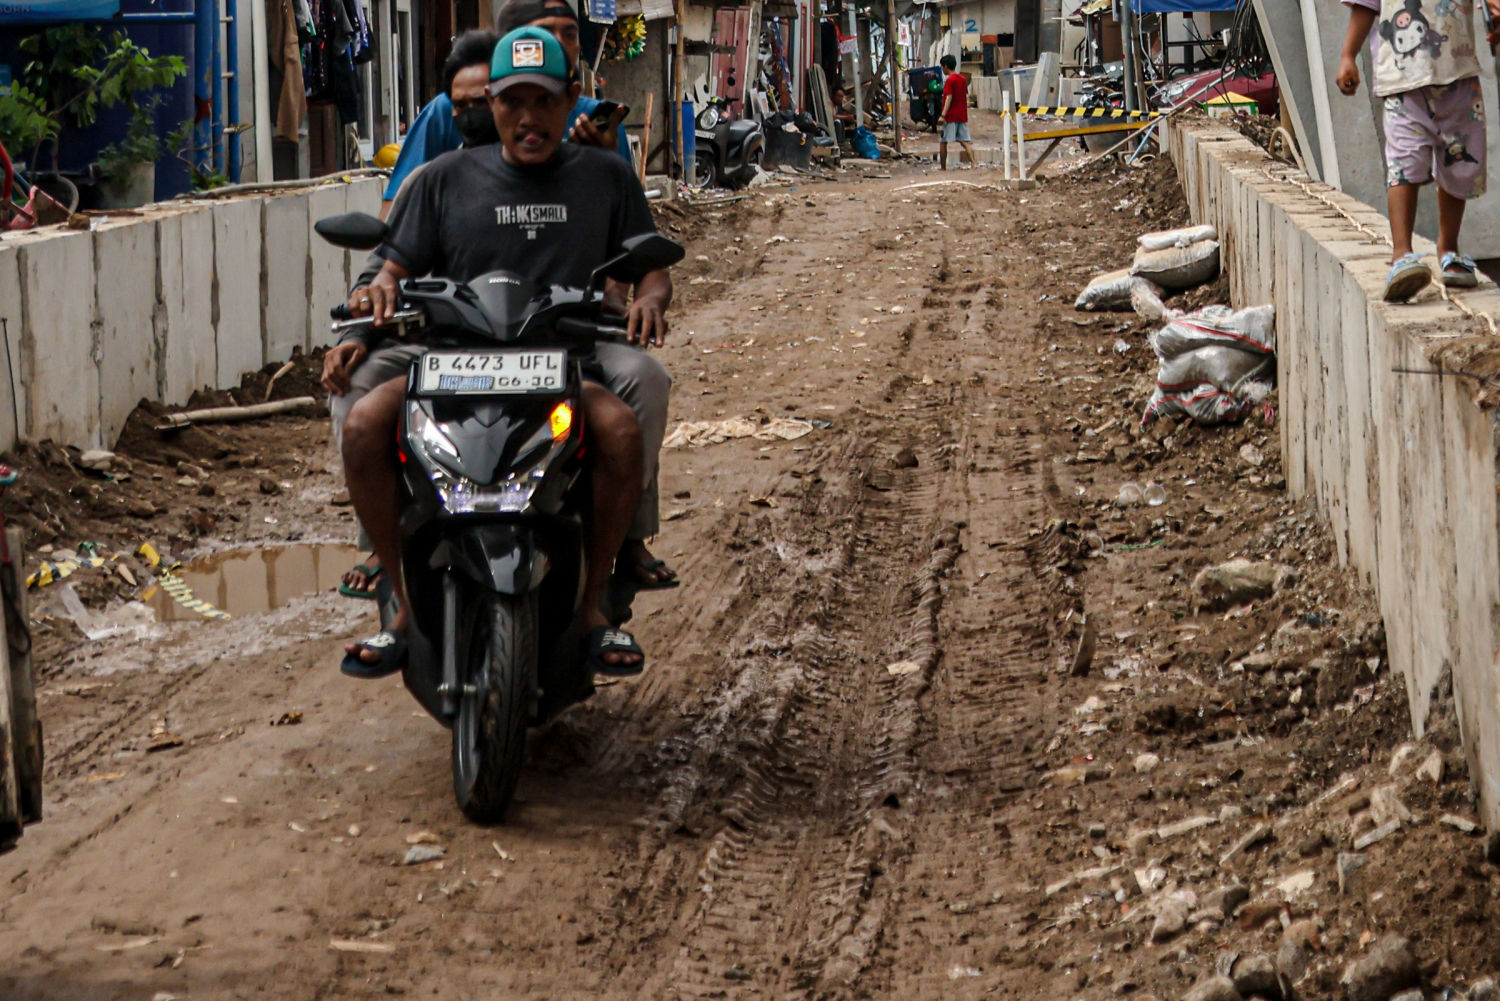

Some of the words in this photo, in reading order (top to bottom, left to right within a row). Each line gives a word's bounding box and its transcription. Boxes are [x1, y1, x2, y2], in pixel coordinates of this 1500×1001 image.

[965, 19, 978, 32] 2
[532, 206, 566, 222] SMALL
[429, 357, 440, 371] B
[452, 356, 503, 371] 4473
[519, 355, 557, 369] UFL
